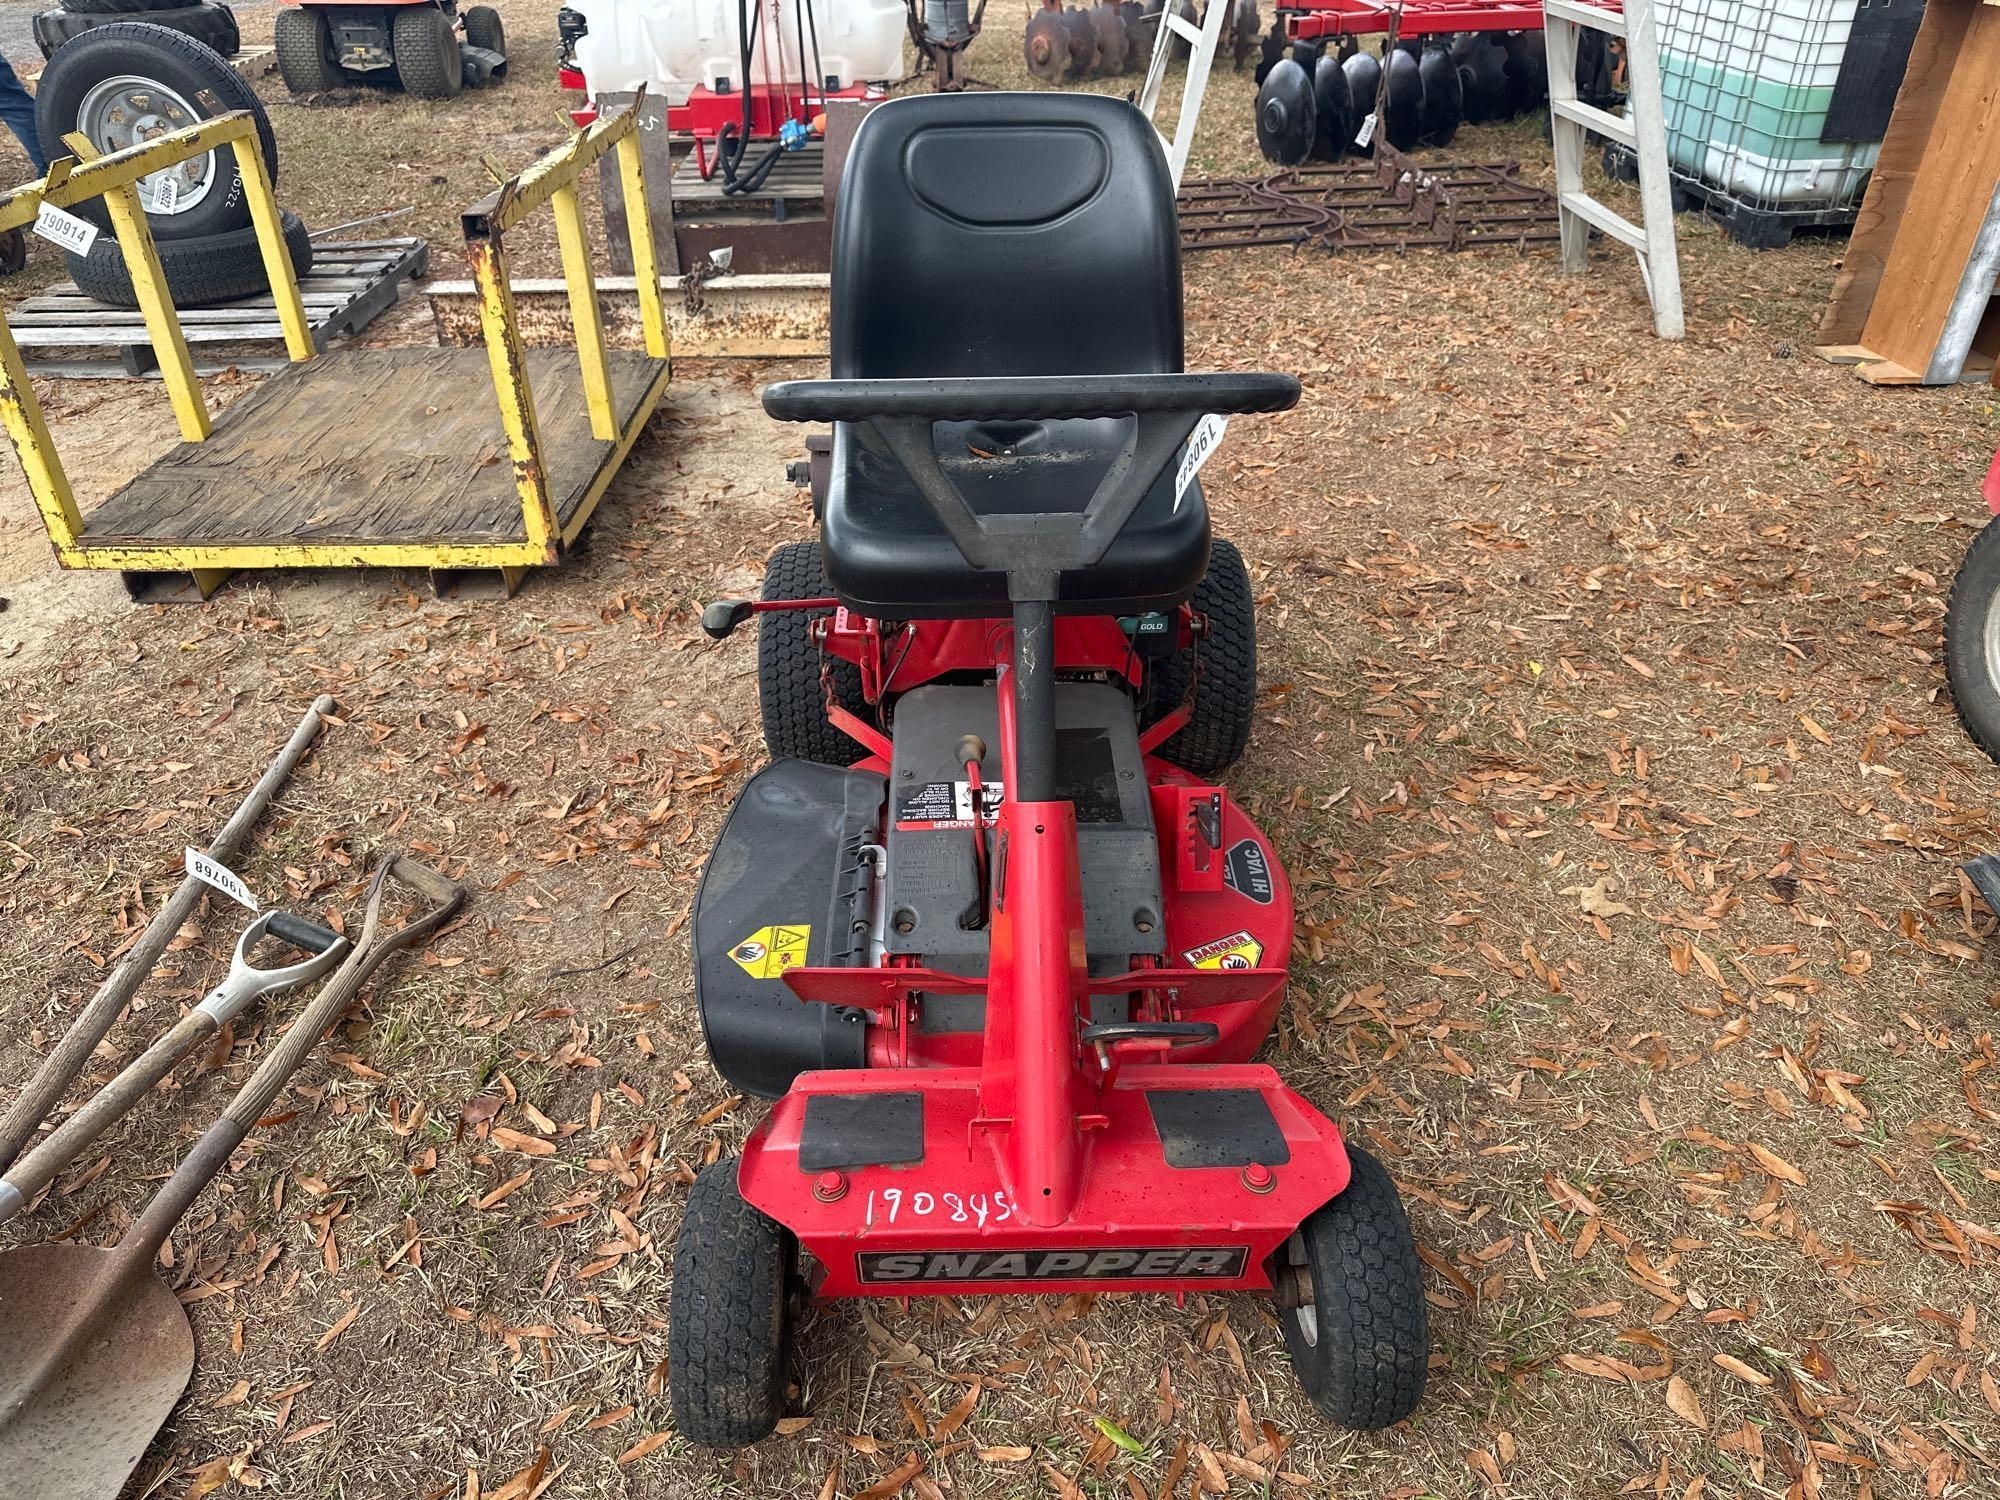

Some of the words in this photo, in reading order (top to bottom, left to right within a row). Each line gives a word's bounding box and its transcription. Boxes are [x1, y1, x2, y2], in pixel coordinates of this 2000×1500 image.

[43, 212, 86, 243] 190914
[1179, 422, 1217, 493] 190845
[933, 820, 985, 829] ANGER
[195, 861, 243, 898] 190768
[1251, 878, 1270, 894] HI
[1190, 935, 1248, 960] DANGER
[866, 1188, 1016, 1227] 190845
[873, 1250, 1234, 1279] SNAPPER
